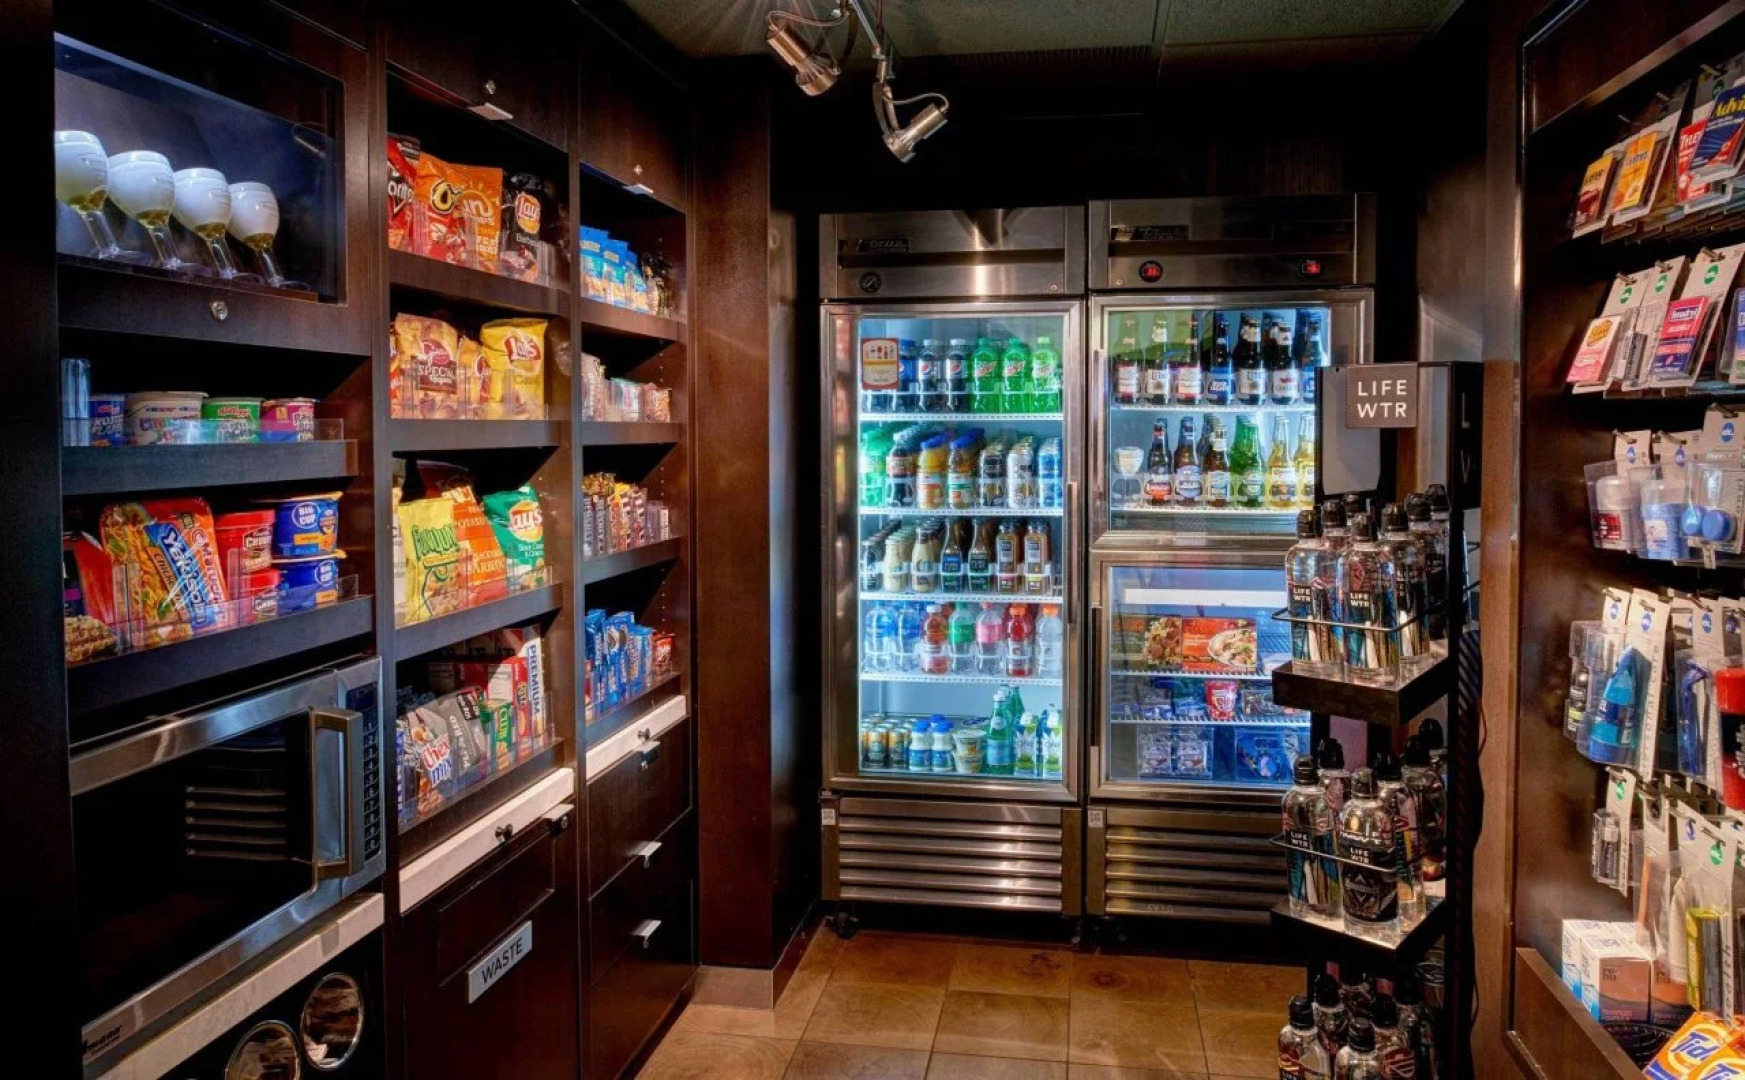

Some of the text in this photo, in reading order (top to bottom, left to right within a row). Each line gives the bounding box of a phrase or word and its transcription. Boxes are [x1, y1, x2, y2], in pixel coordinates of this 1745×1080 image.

[1358, 380, 1407, 396] LIFE
[1357, 402, 1407, 418] WTR
[299, 506, 315, 516] BIG
[300, 516, 316, 526] CUP
[1293, 587, 1310, 595] LIFE
[1350, 592, 1368, 600] LIFE
[1351, 600, 1369, 608] WTR
[529, 644, 541, 715] PREMIUM
[481, 936, 523, 984] WASTE
[1670, 1031, 1720, 1062] Tid
